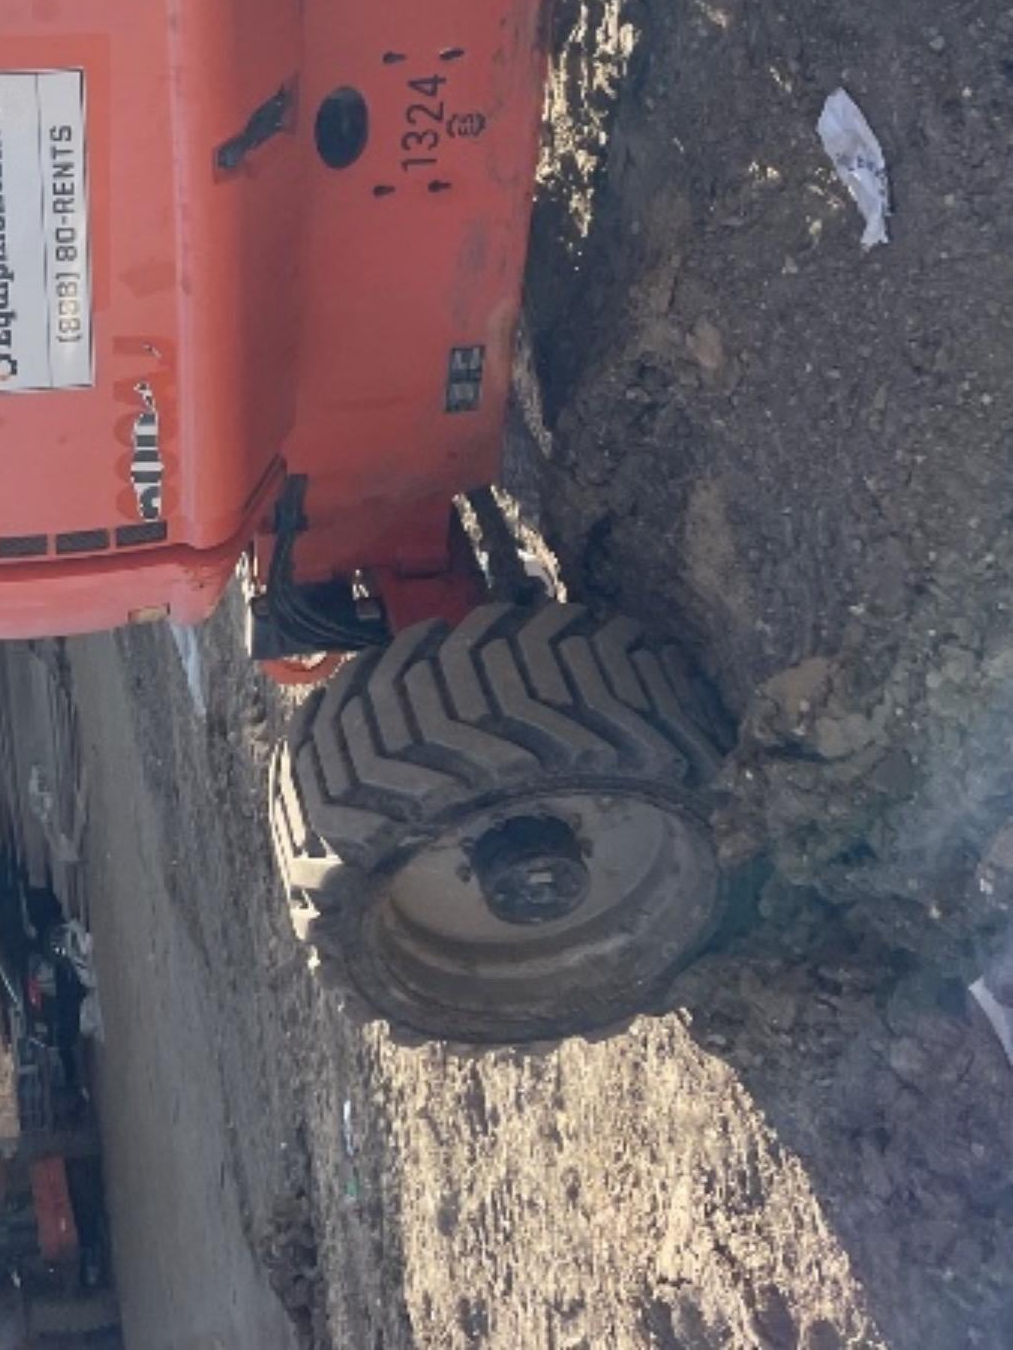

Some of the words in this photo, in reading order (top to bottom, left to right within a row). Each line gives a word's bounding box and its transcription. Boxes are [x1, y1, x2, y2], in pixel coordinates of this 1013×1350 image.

[399, 74, 447, 172] 1324
[49, 125, 78, 262] 80-RENTS
[54, 271, 82, 343] (888)
